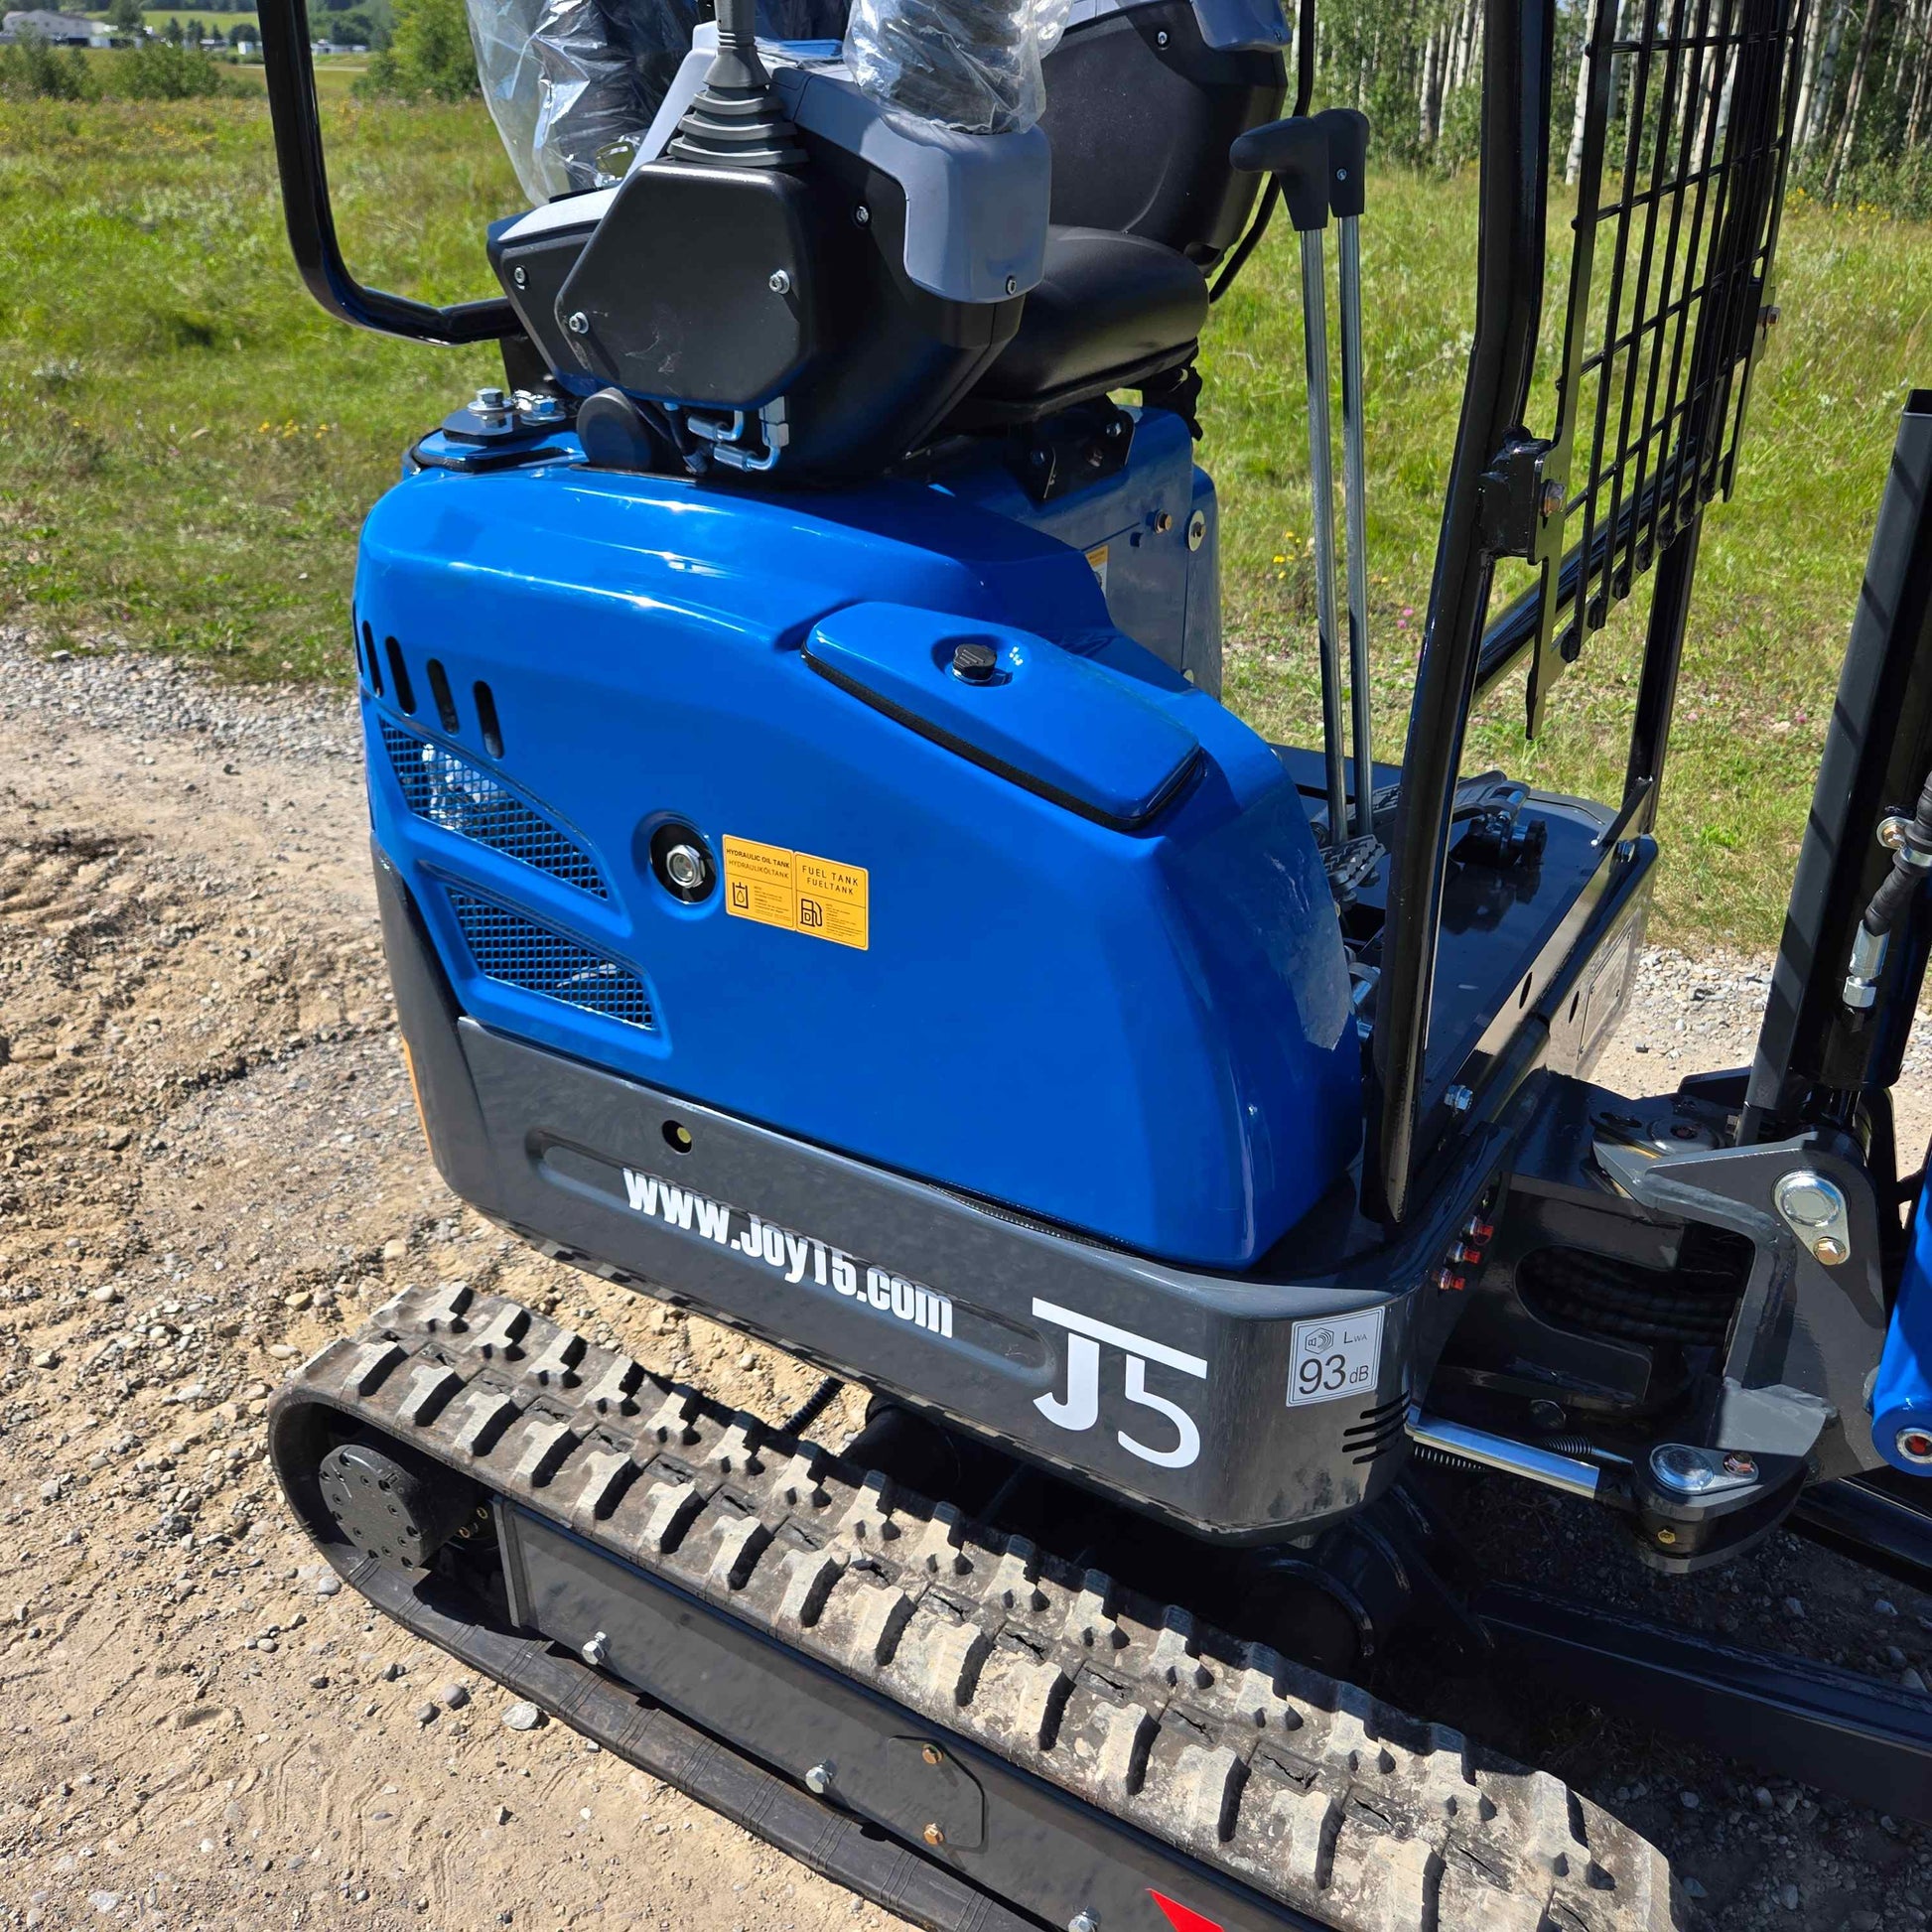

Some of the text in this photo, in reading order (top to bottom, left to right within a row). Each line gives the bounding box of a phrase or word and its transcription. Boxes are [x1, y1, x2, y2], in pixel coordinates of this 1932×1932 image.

[726, 849, 760, 862] HYDRAULIC
[773, 859, 790, 869] TANK
[802, 865, 859, 887] FUEL TANK
[807, 878, 854, 896] FUELTANK
[1299, 1354, 1369, 1395] 93 dB
